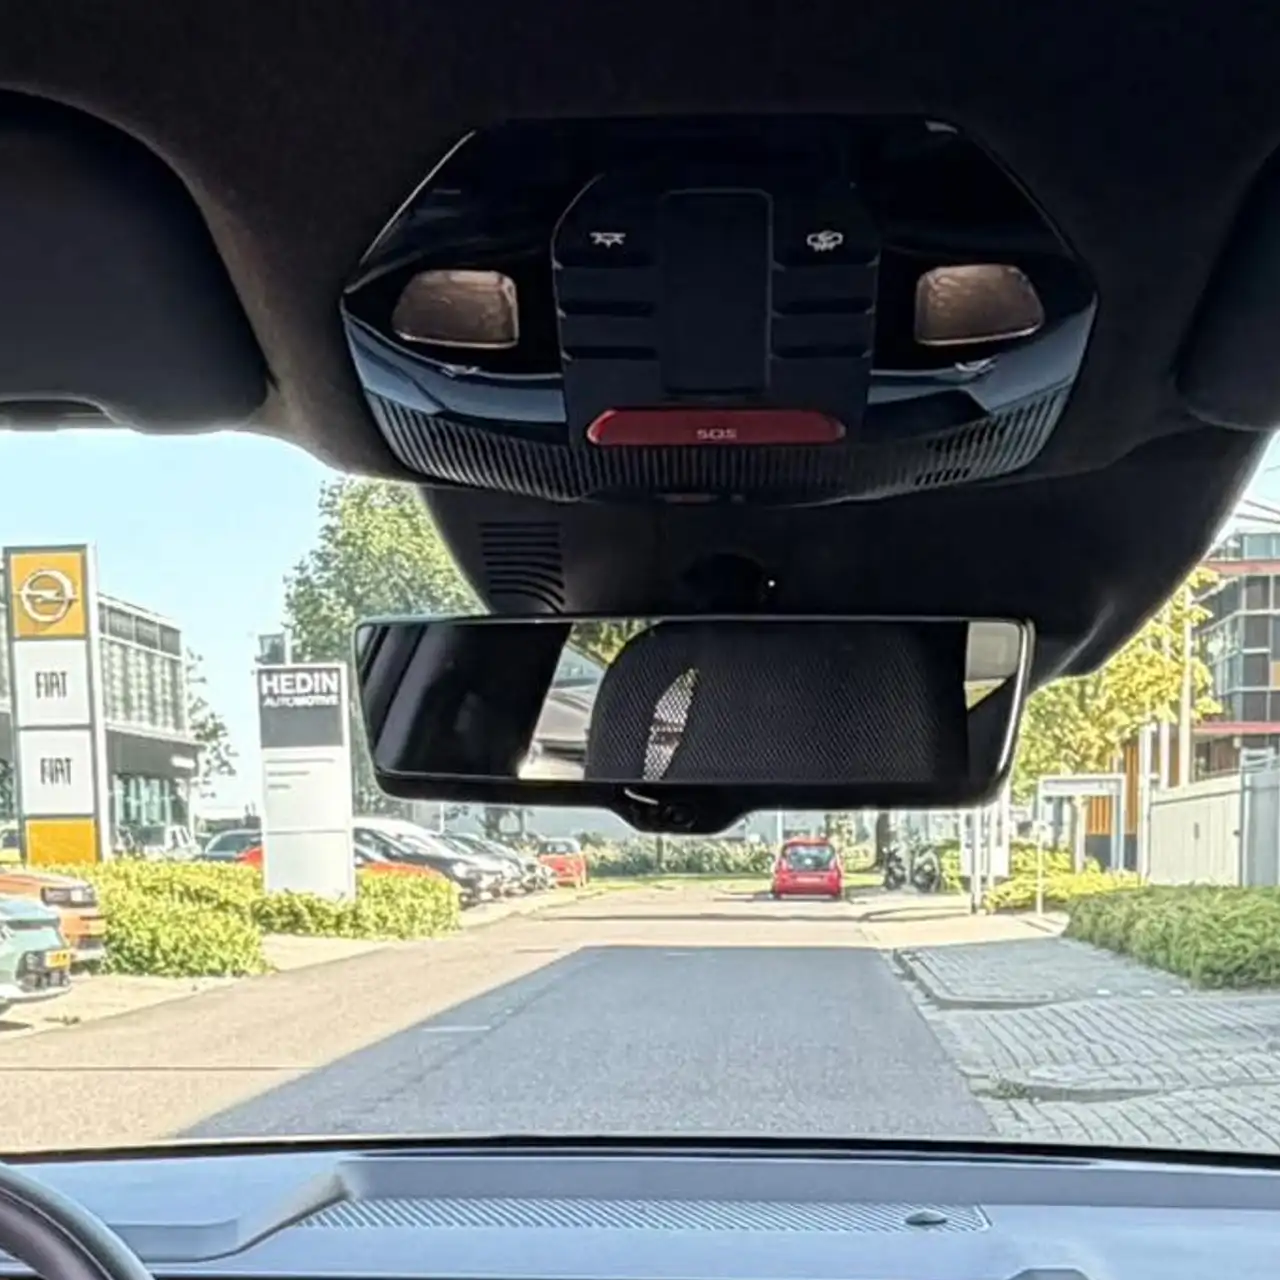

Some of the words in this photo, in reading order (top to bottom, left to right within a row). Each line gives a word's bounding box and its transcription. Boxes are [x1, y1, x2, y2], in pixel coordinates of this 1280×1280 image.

[696, 428, 738, 440] SOS
[35, 671, 67, 698] FIAT
[261, 671, 339, 695] HEDIN
[264, 694, 340, 708] AUTOMOTIVE
[40, 757, 72, 786] FIAT
